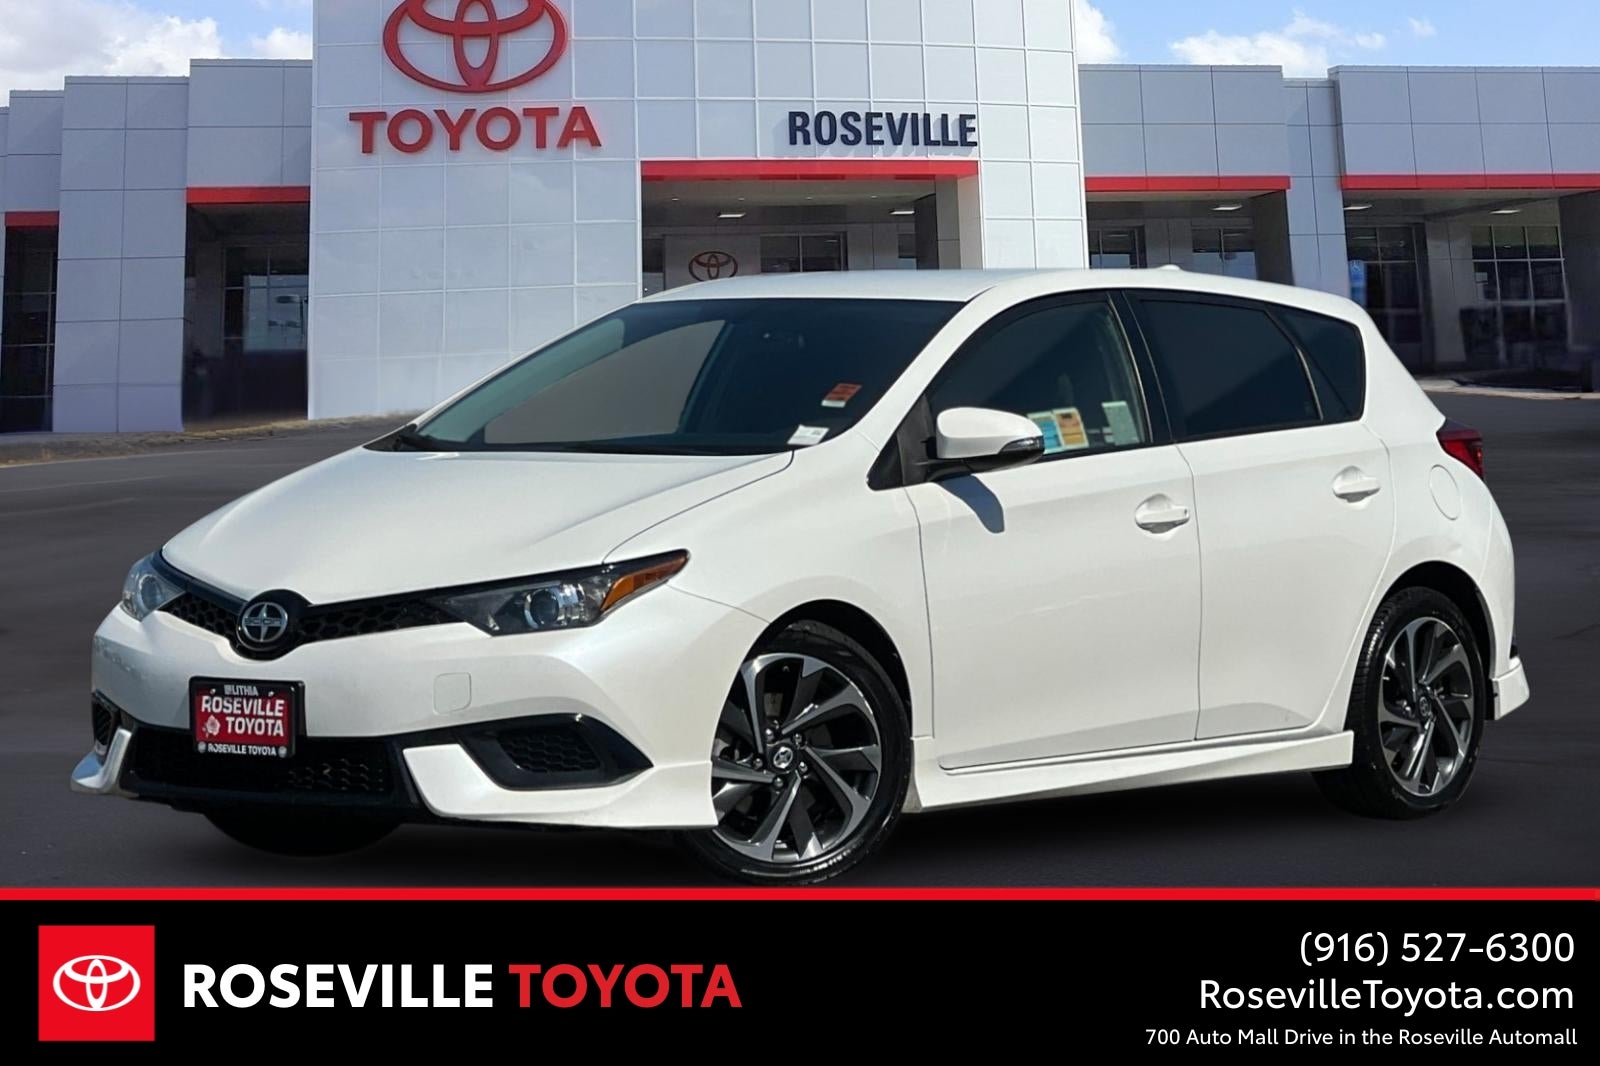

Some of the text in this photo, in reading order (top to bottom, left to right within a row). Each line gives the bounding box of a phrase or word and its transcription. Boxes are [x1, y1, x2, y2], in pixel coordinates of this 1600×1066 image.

[349, 106, 602, 154] TOYOTA
[788, 110, 978, 149] ROSEVILLE
[231, 685, 258, 696] LITHIA
[201, 695, 285, 717] ROSEVILLE
[225, 717, 284, 737] TOYOTA
[207, 743, 247, 754] ROSEVILLE
[248, 745, 277, 756] TOYOTA
